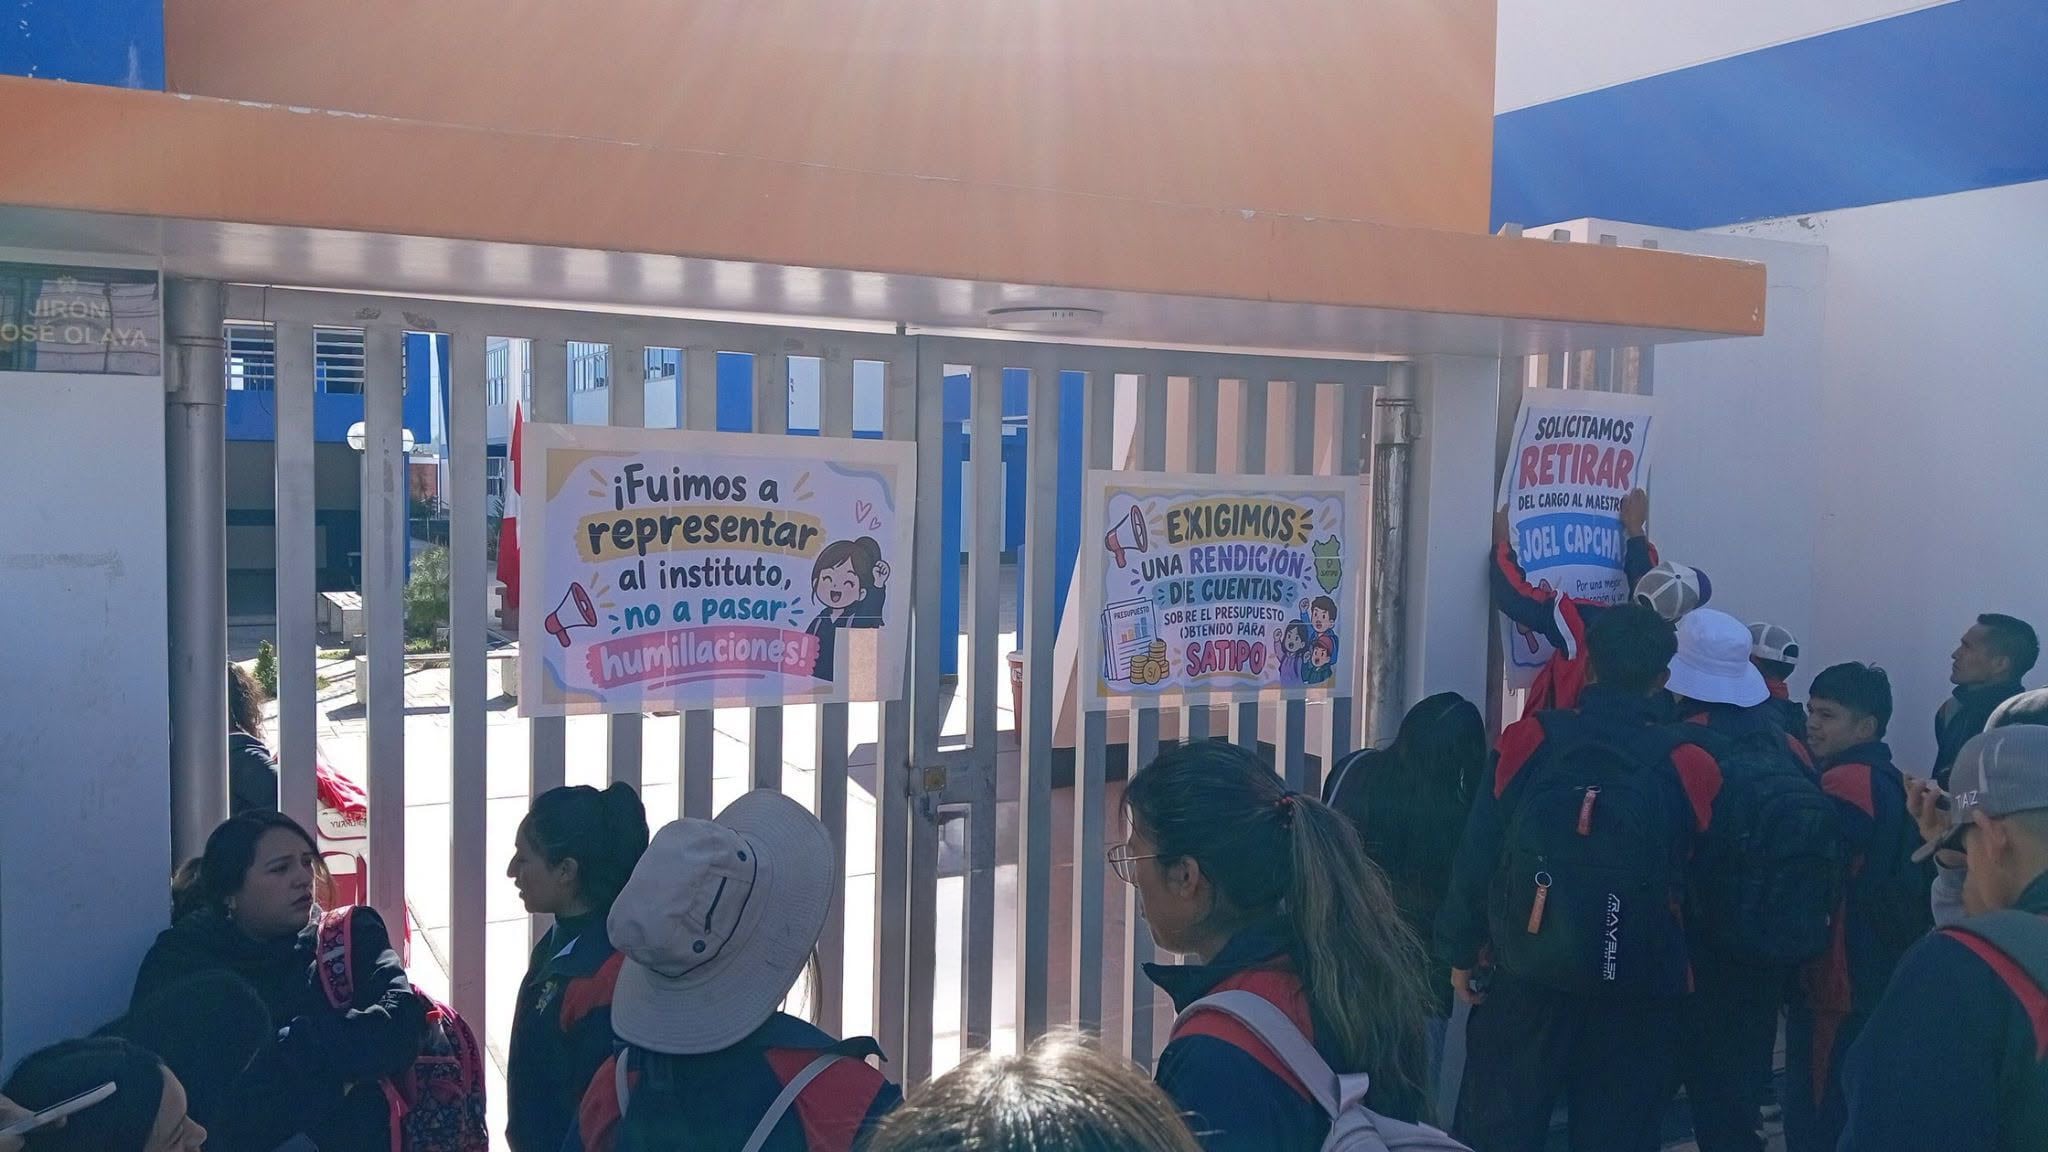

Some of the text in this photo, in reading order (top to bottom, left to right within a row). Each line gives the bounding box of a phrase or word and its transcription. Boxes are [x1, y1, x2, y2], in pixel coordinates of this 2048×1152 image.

[28, 296, 107, 319] JIRÓN
[64, 326, 148, 347] OLAYA
[1535, 415, 1634, 444] SOLICITAMOS
[1518, 443, 1635, 491] RETIRAR
[614, 463, 778, 510] ¡Fuimos a
[1518, 495, 1535, 511] DEL
[1538, 493, 1569, 508] CARGO
[1572, 493, 1583, 507] AL
[587, 512, 818, 556] representar
[1166, 503, 1296, 544] EXIGIMOS
[1523, 524, 1621, 562] JOEL CAPCHA
[618, 557, 791, 591] al instituto,
[1141, 543, 1305, 582] UNA RENDICIÓN
[1169, 577, 1283, 605] DE CUENTAS
[624, 597, 787, 630] no a pasar
[1113, 606, 1150, 619] PRESUPUESTO
[1164, 606, 1284, 625] SOBRE EL PRESUPUESTO
[1180, 622, 1265, 639] OBTENIDO PARA
[599, 631, 807, 681] humillaciones!
[1186, 639, 1267, 677] SATIPO
[1955, 790, 1978, 809] TAZ
